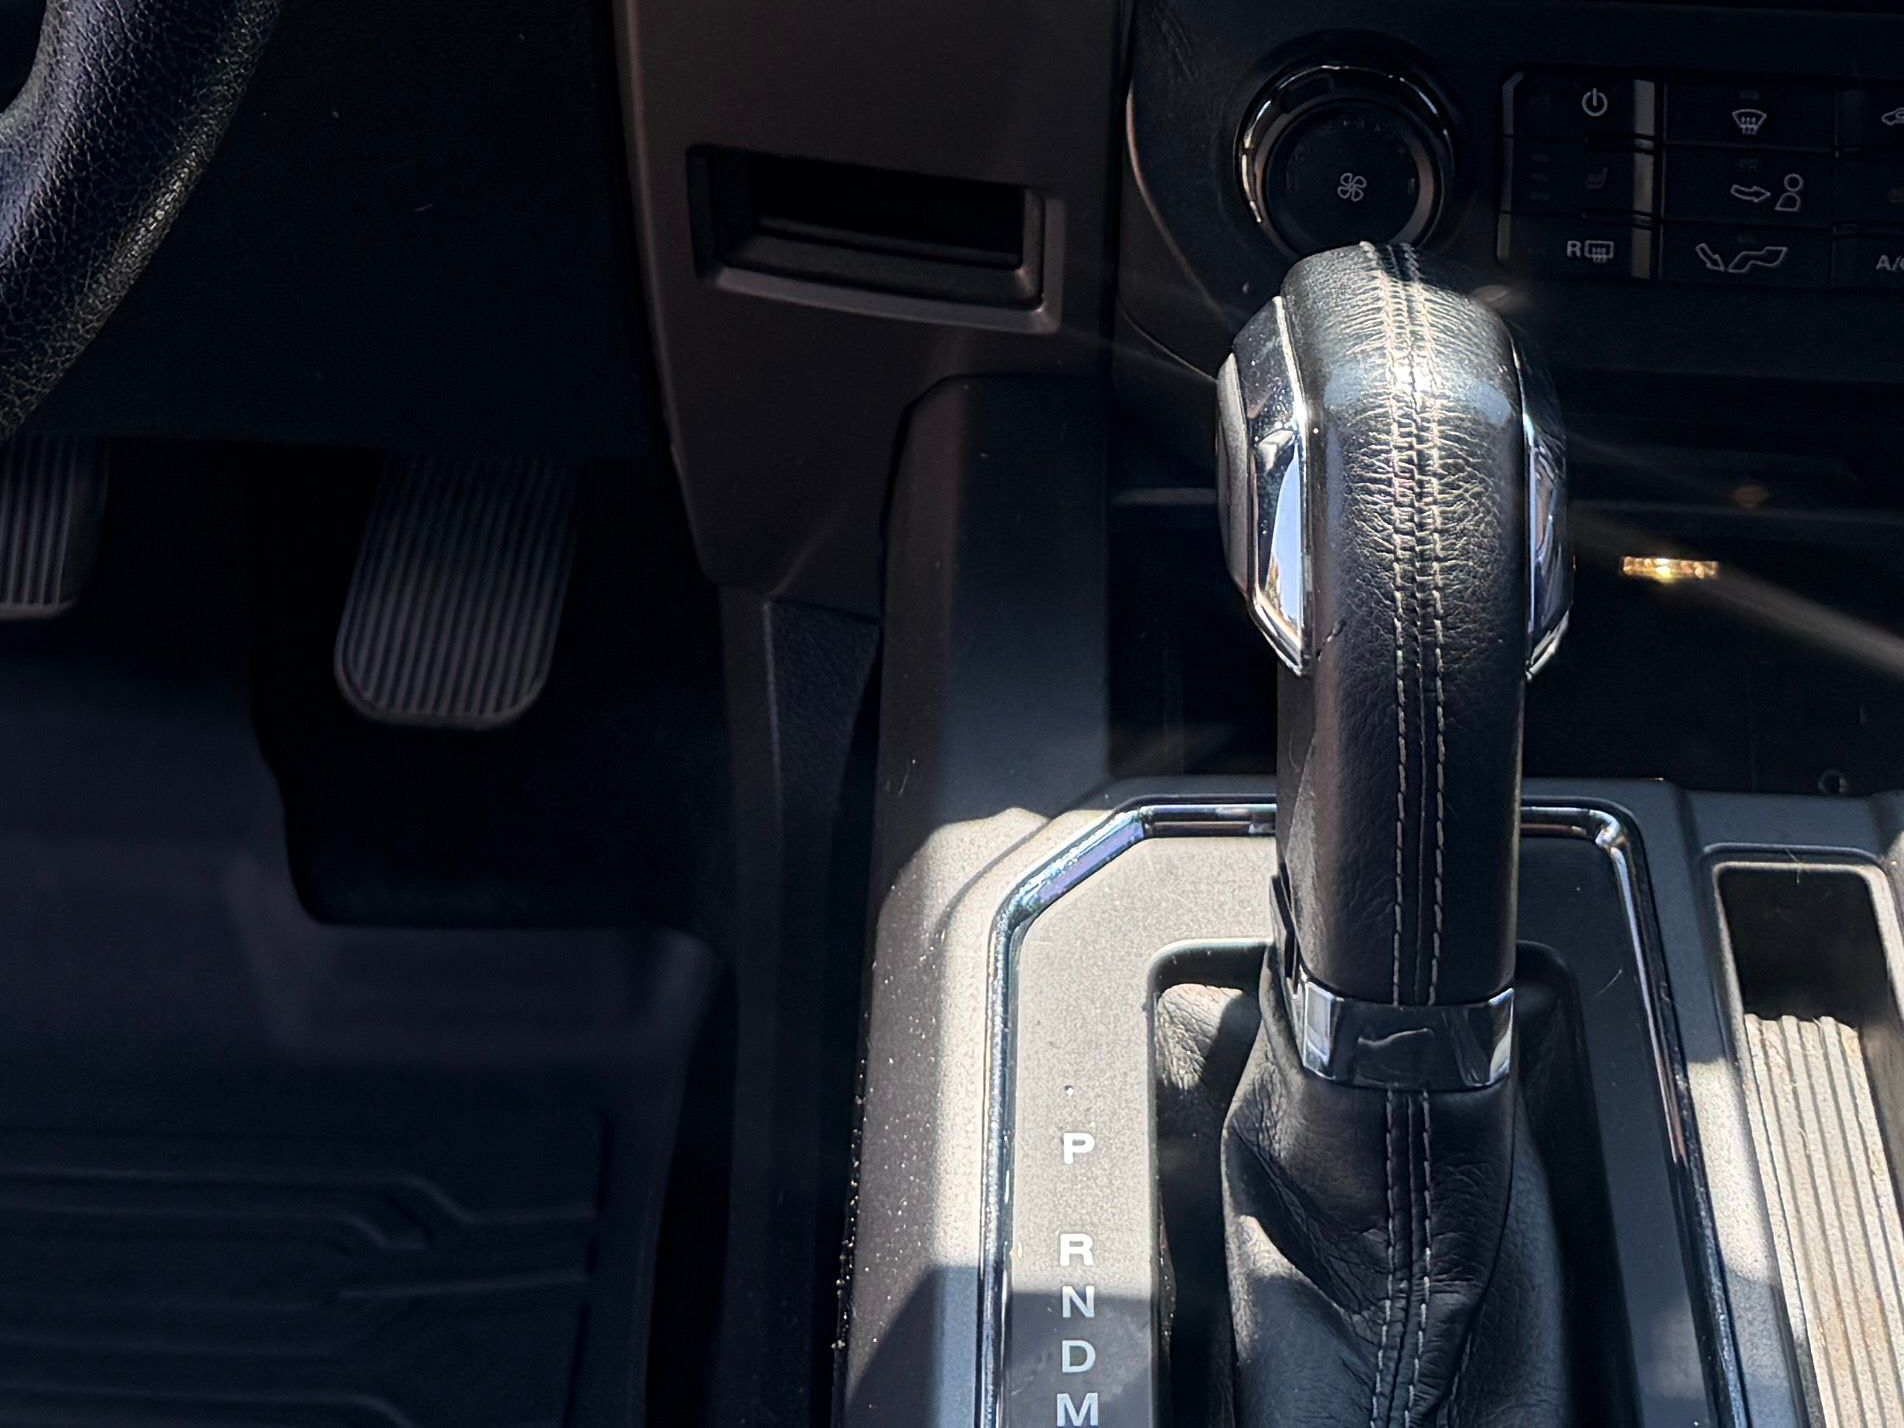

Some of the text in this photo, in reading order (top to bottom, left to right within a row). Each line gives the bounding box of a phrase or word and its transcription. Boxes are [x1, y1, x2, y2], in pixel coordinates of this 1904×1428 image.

[1566, 240, 1582, 258] R
[1055, 1131, 1100, 1428] P R N D M
